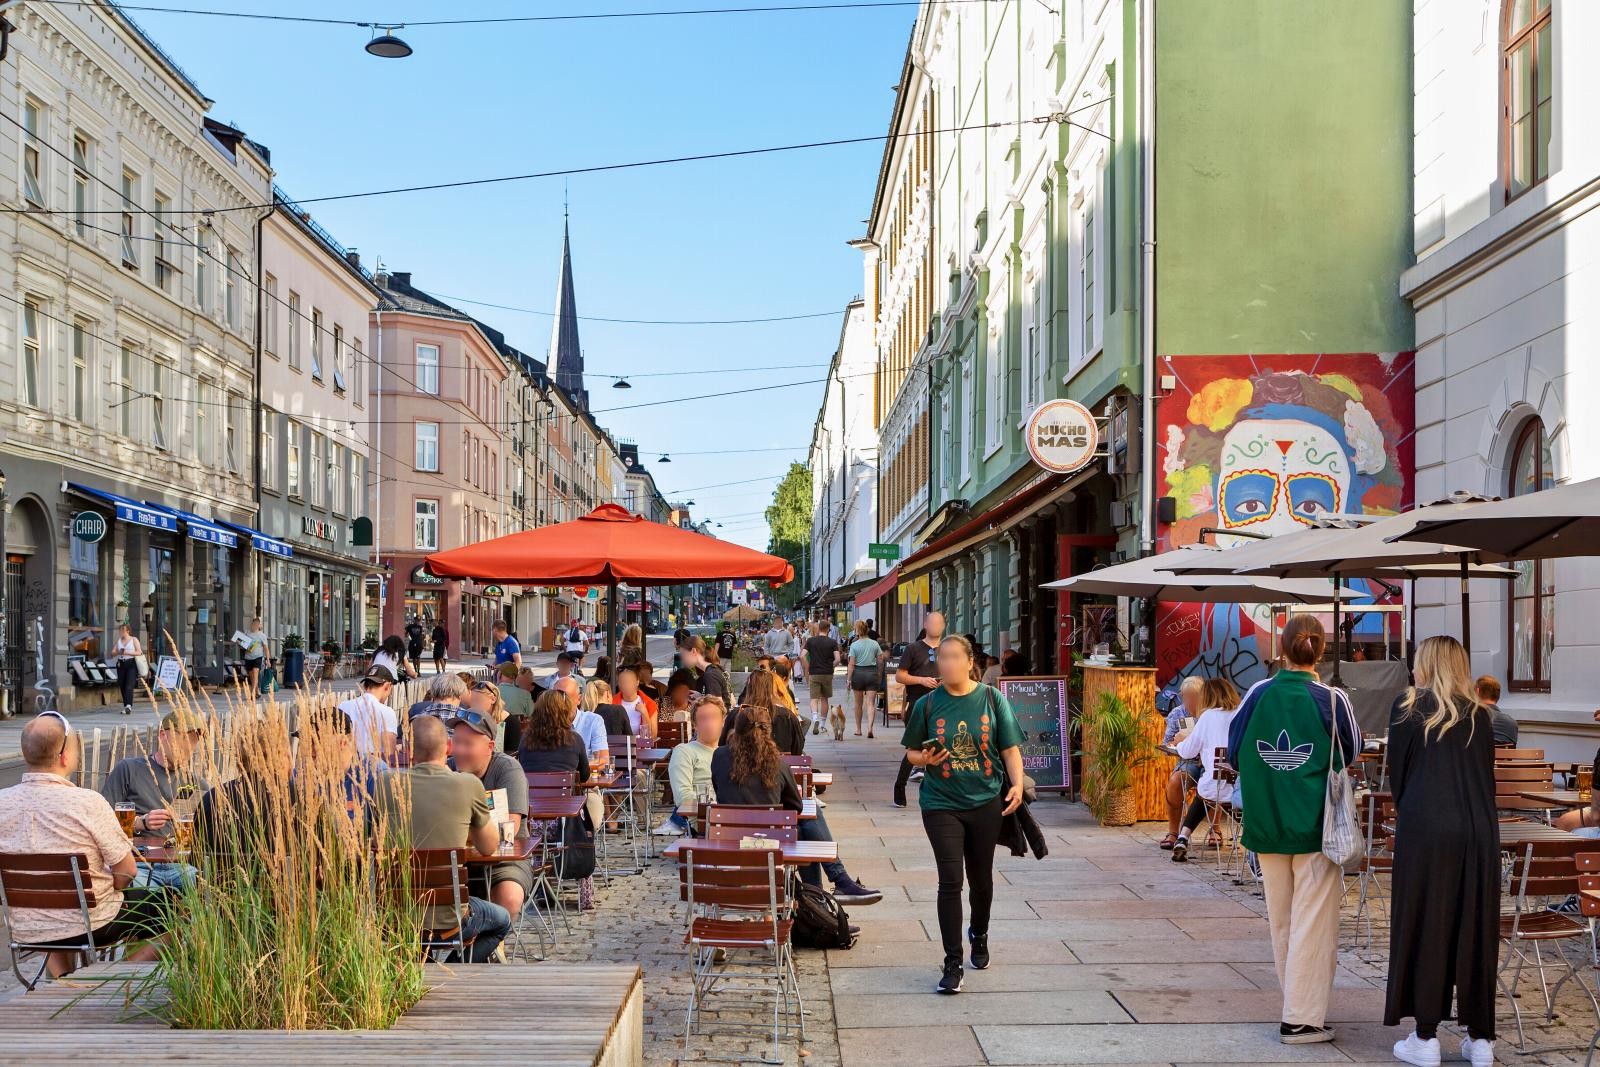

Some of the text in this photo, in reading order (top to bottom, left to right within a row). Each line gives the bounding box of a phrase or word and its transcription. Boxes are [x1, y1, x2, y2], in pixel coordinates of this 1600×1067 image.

[1038, 425, 1087, 435] MUCHO
[1038, 437, 1088, 448] MAS
[76, 519, 102, 534] CHAIR
